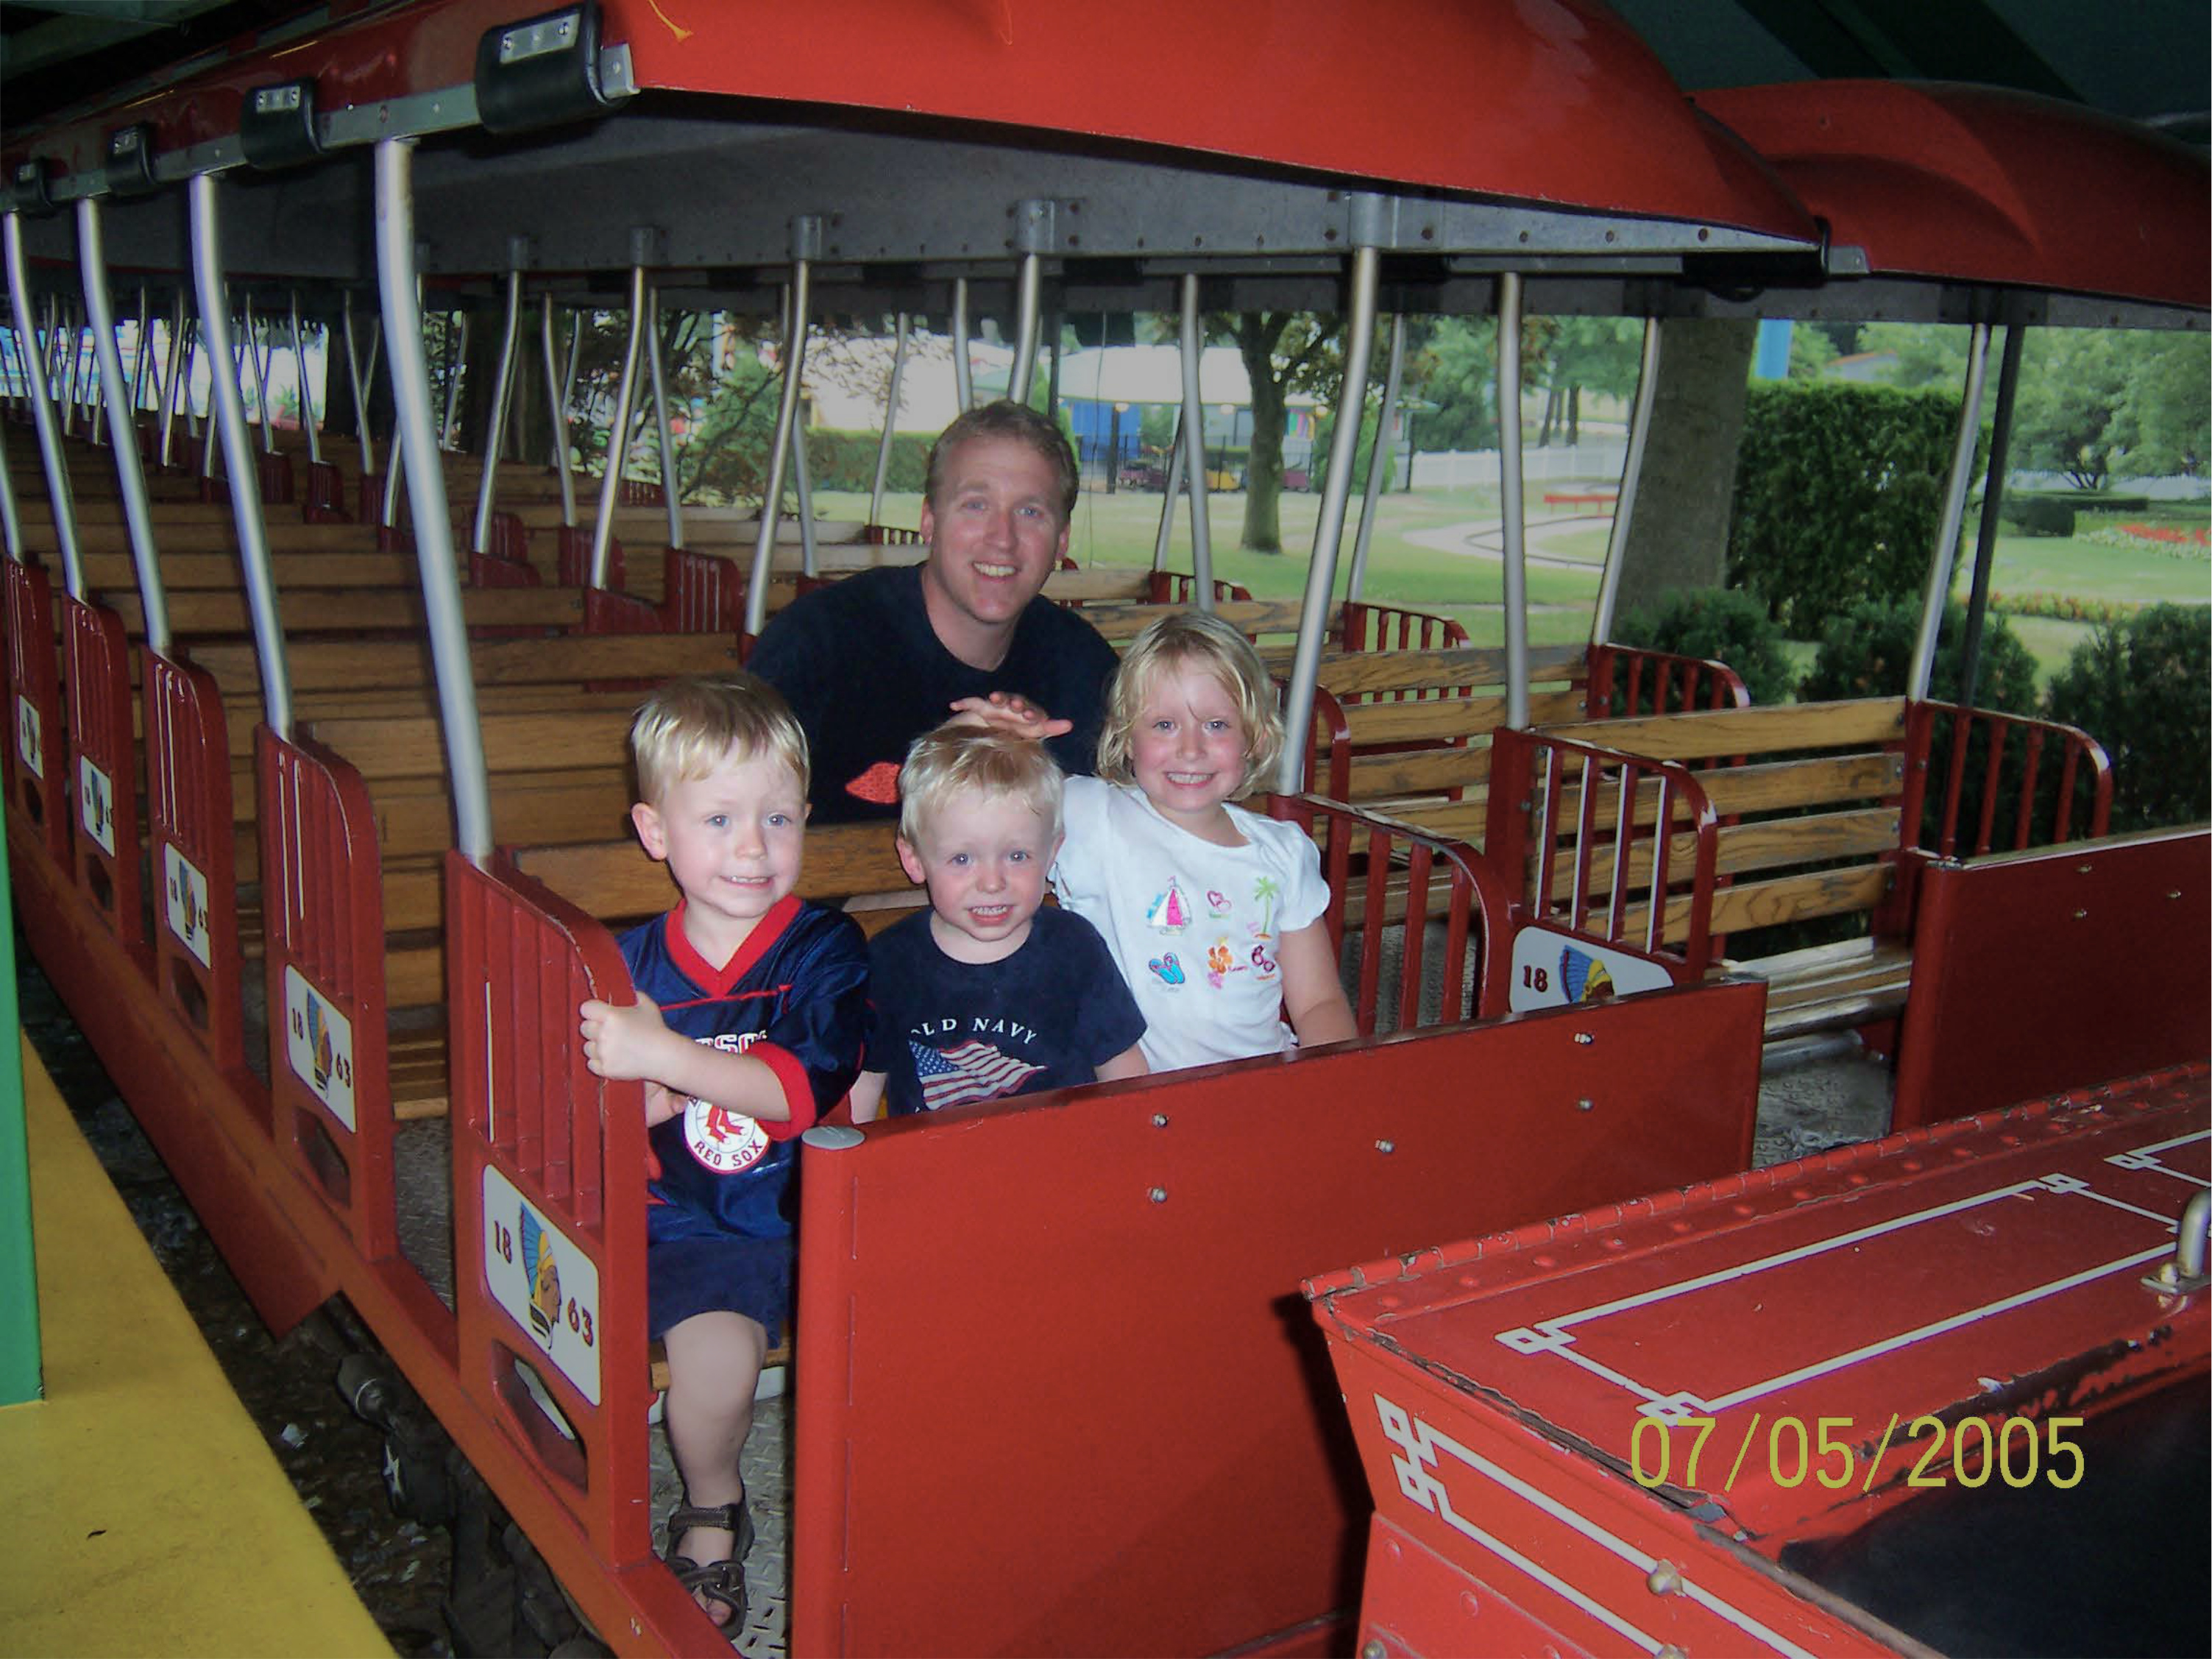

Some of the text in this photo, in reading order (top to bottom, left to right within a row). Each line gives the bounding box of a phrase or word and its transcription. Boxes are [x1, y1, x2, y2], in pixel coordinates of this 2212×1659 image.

[1522, 965, 1548, 992] 18
[972, 1017, 1038, 1044] NAVY
[292, 1008, 351, 1089] 18 63
[694, 1139, 763, 1167] RED SOX
[494, 1220, 594, 1348] 18 63
